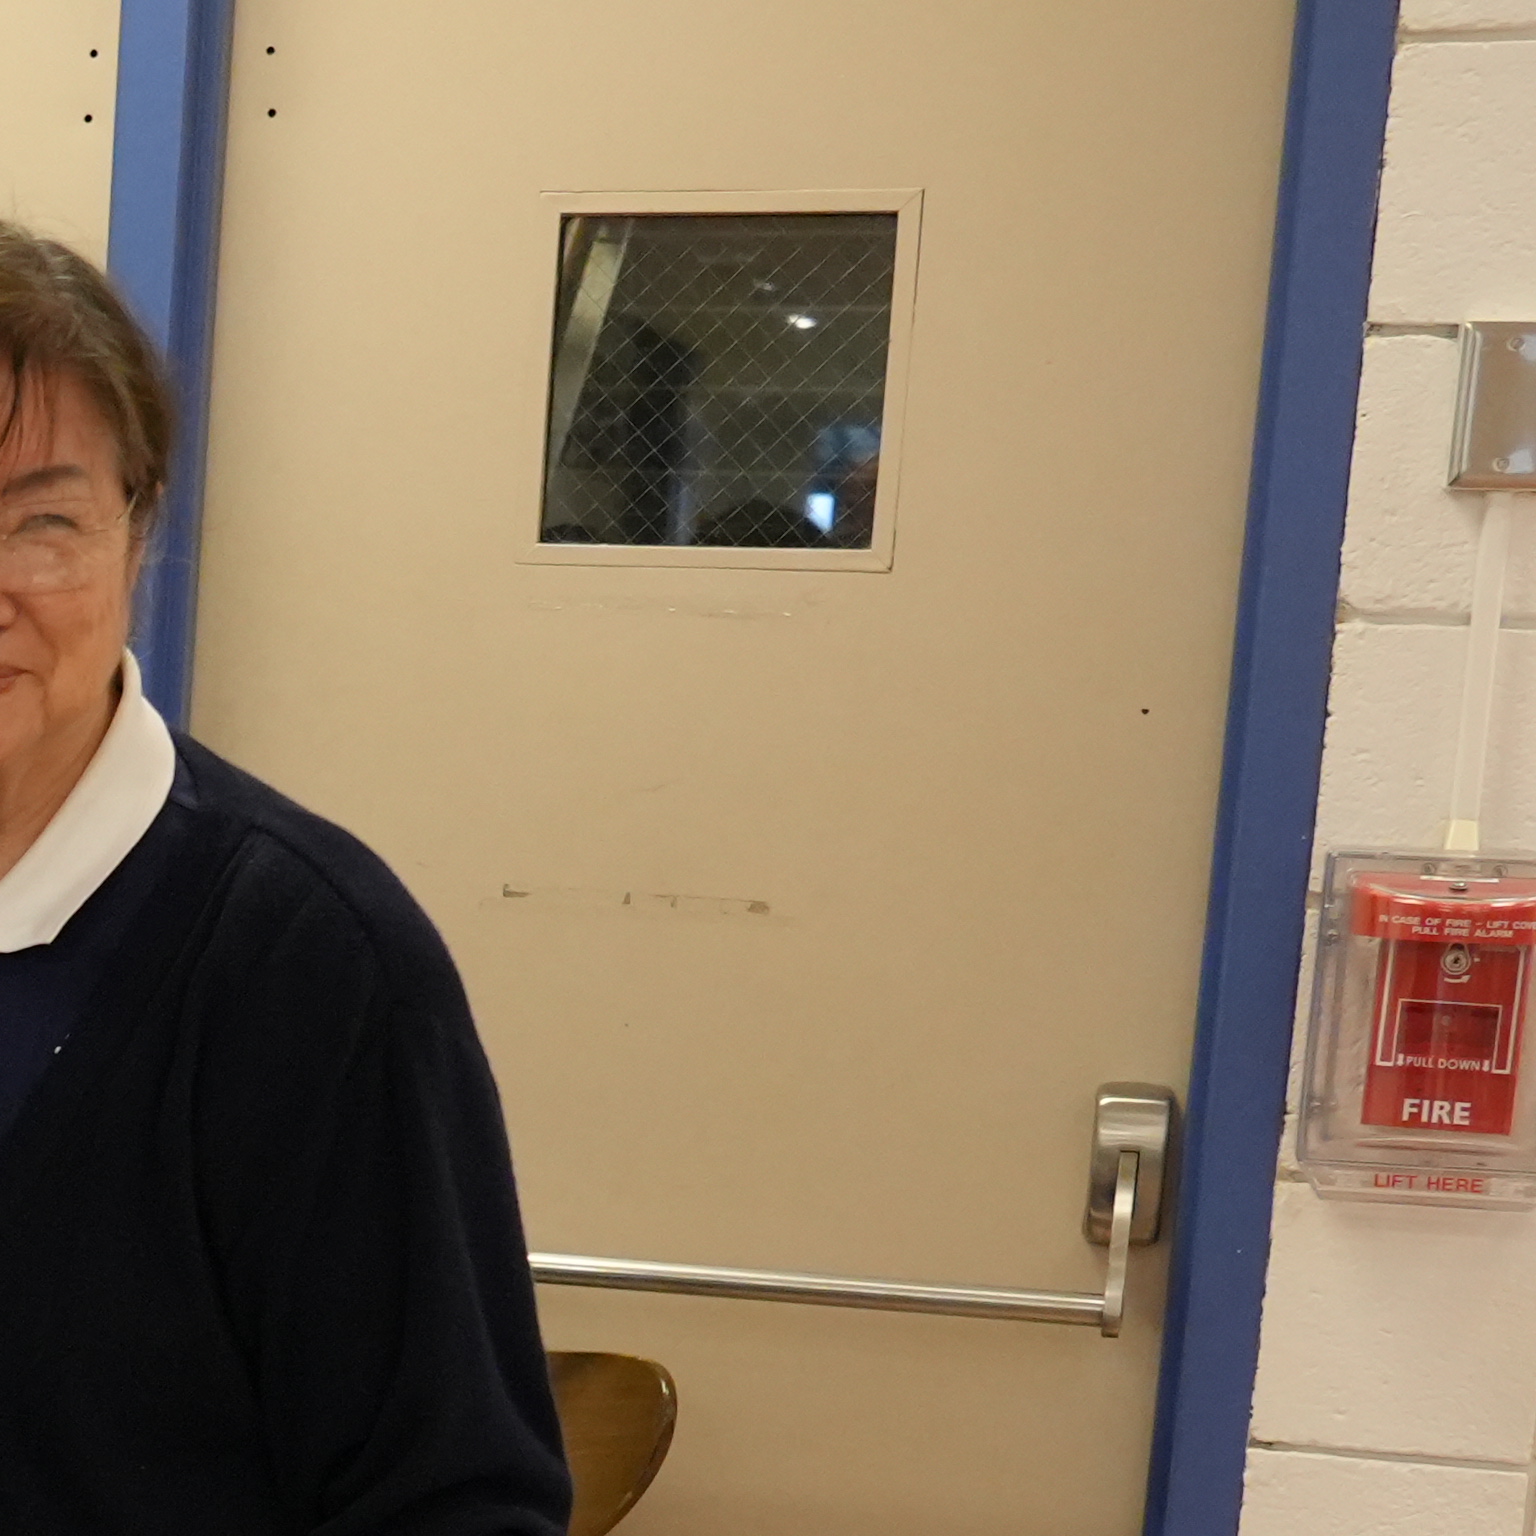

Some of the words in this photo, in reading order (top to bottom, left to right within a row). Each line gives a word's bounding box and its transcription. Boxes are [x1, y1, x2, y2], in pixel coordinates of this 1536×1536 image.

[1406, 1055, 1434, 1069] PULL
[1438, 1057, 1481, 1072] DOWN
[1401, 1098, 1472, 1126] FIRE
[1374, 1173, 1418, 1190] LIFT
[1427, 1175, 1485, 1194] HERE
